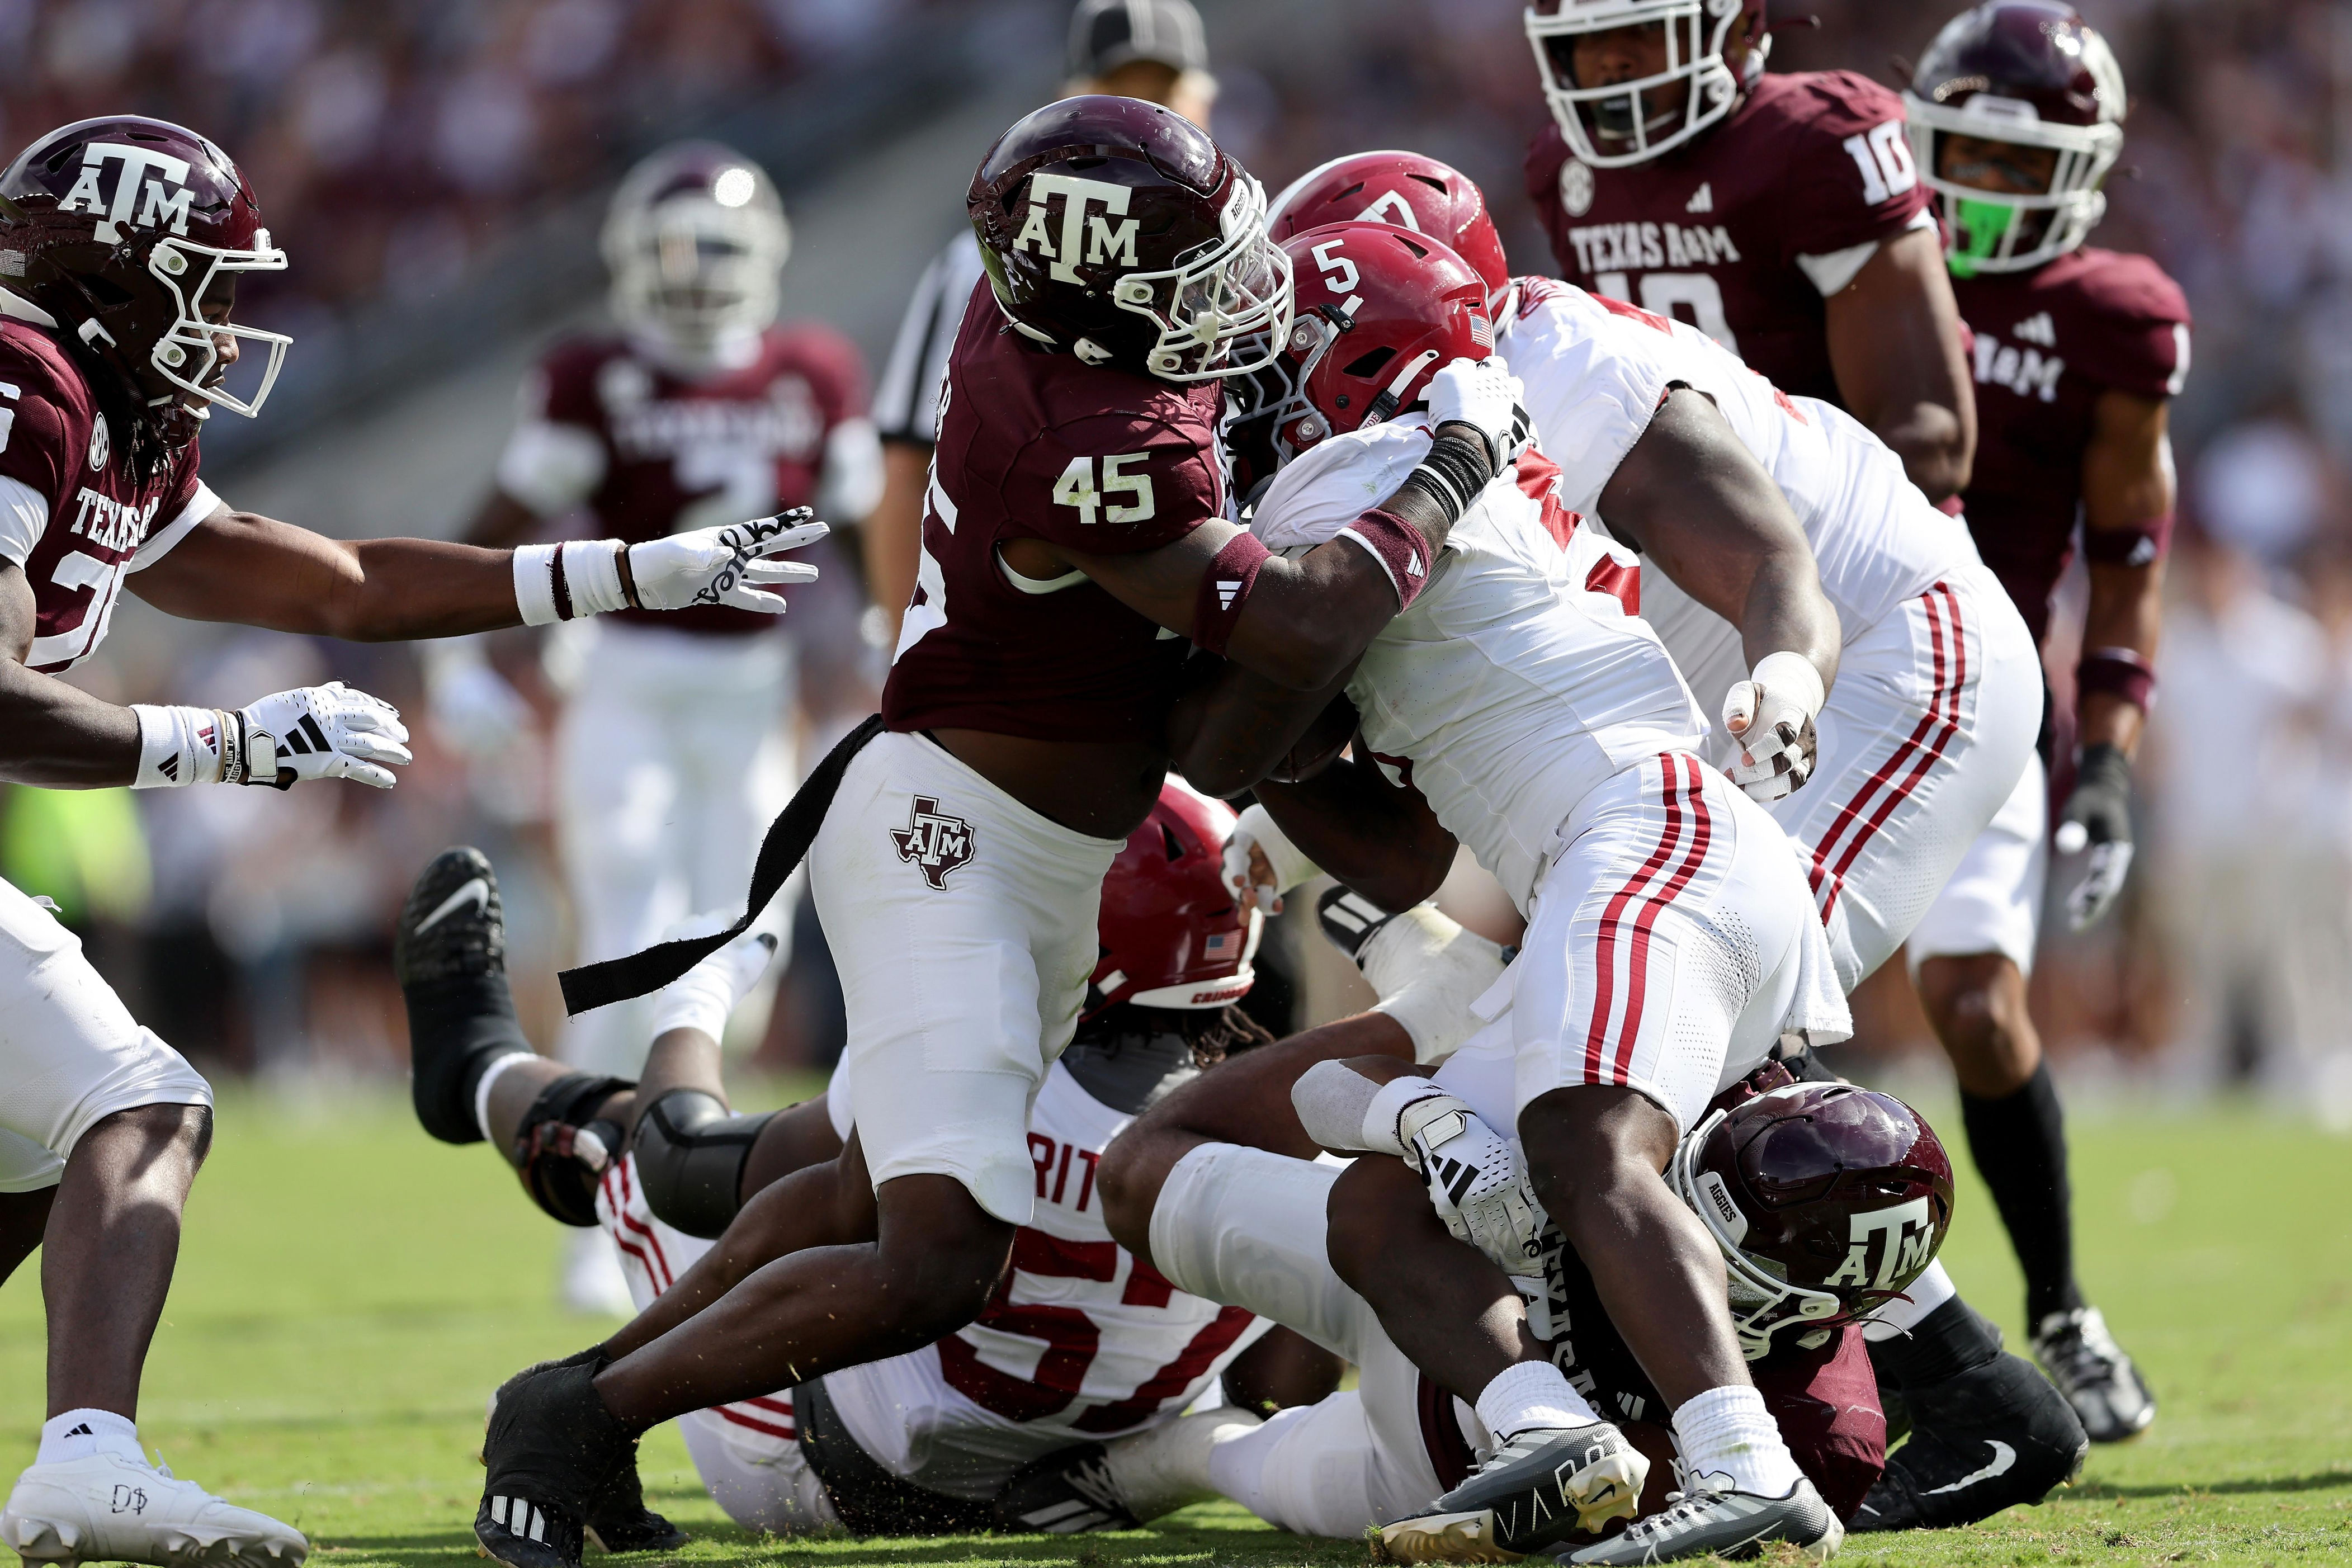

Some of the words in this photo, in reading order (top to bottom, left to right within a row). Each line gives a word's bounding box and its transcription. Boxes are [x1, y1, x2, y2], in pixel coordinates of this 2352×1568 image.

[1843, 119, 1918, 206] 10
[1311, 239, 1361, 294] 5
[1569, 221, 1665, 275] TEXAS
[1666, 225, 1741, 267] A&M
[70, 487, 139, 552] TEXAS
[1053, 452, 1155, 524] 45
[1708, 1182, 1736, 1223] AGGIES
[937, 1226, 1257, 1433] 57
